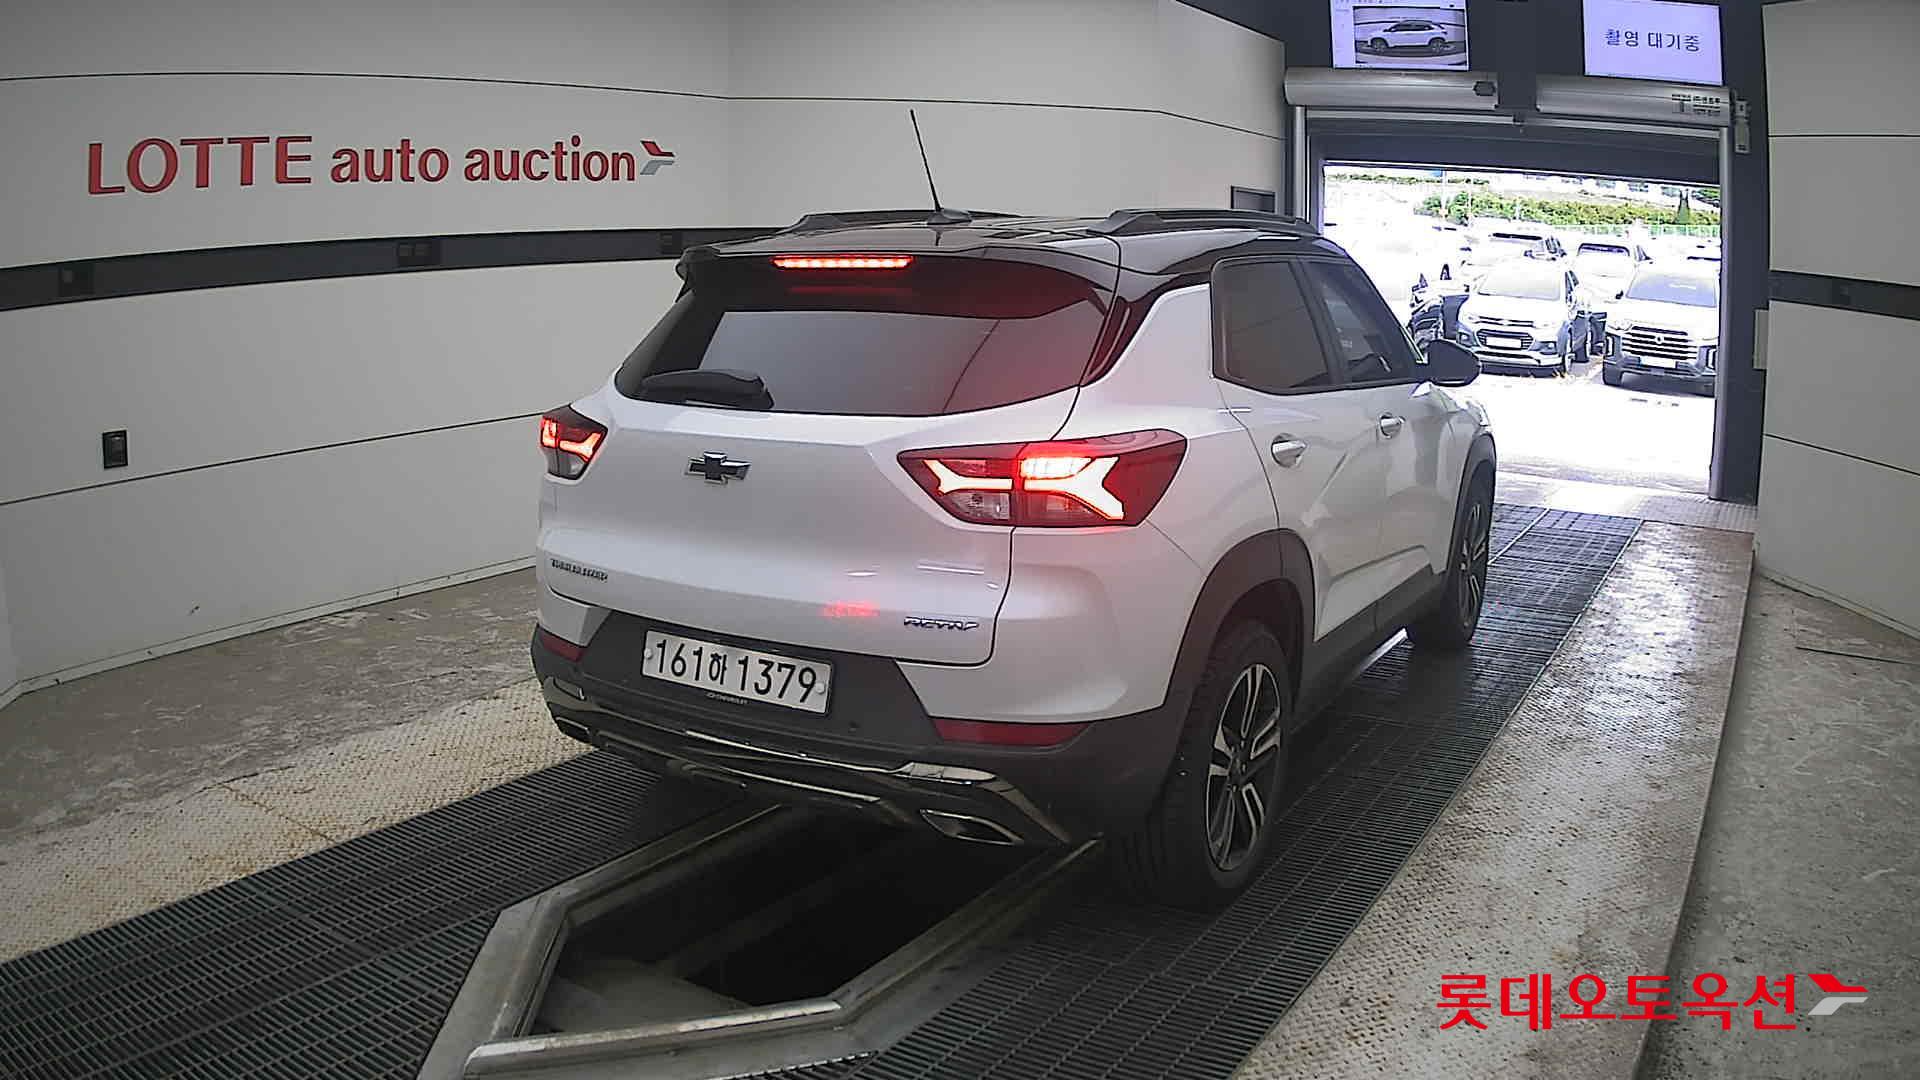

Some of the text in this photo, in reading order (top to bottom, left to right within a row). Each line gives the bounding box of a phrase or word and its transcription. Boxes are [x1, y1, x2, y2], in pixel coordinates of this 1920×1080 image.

[1605, 28, 1700, 52] 촬영 대기중
[88, 135, 636, 195] LOTTE auto auction
[655, 638, 818, 704] 161하 1379
